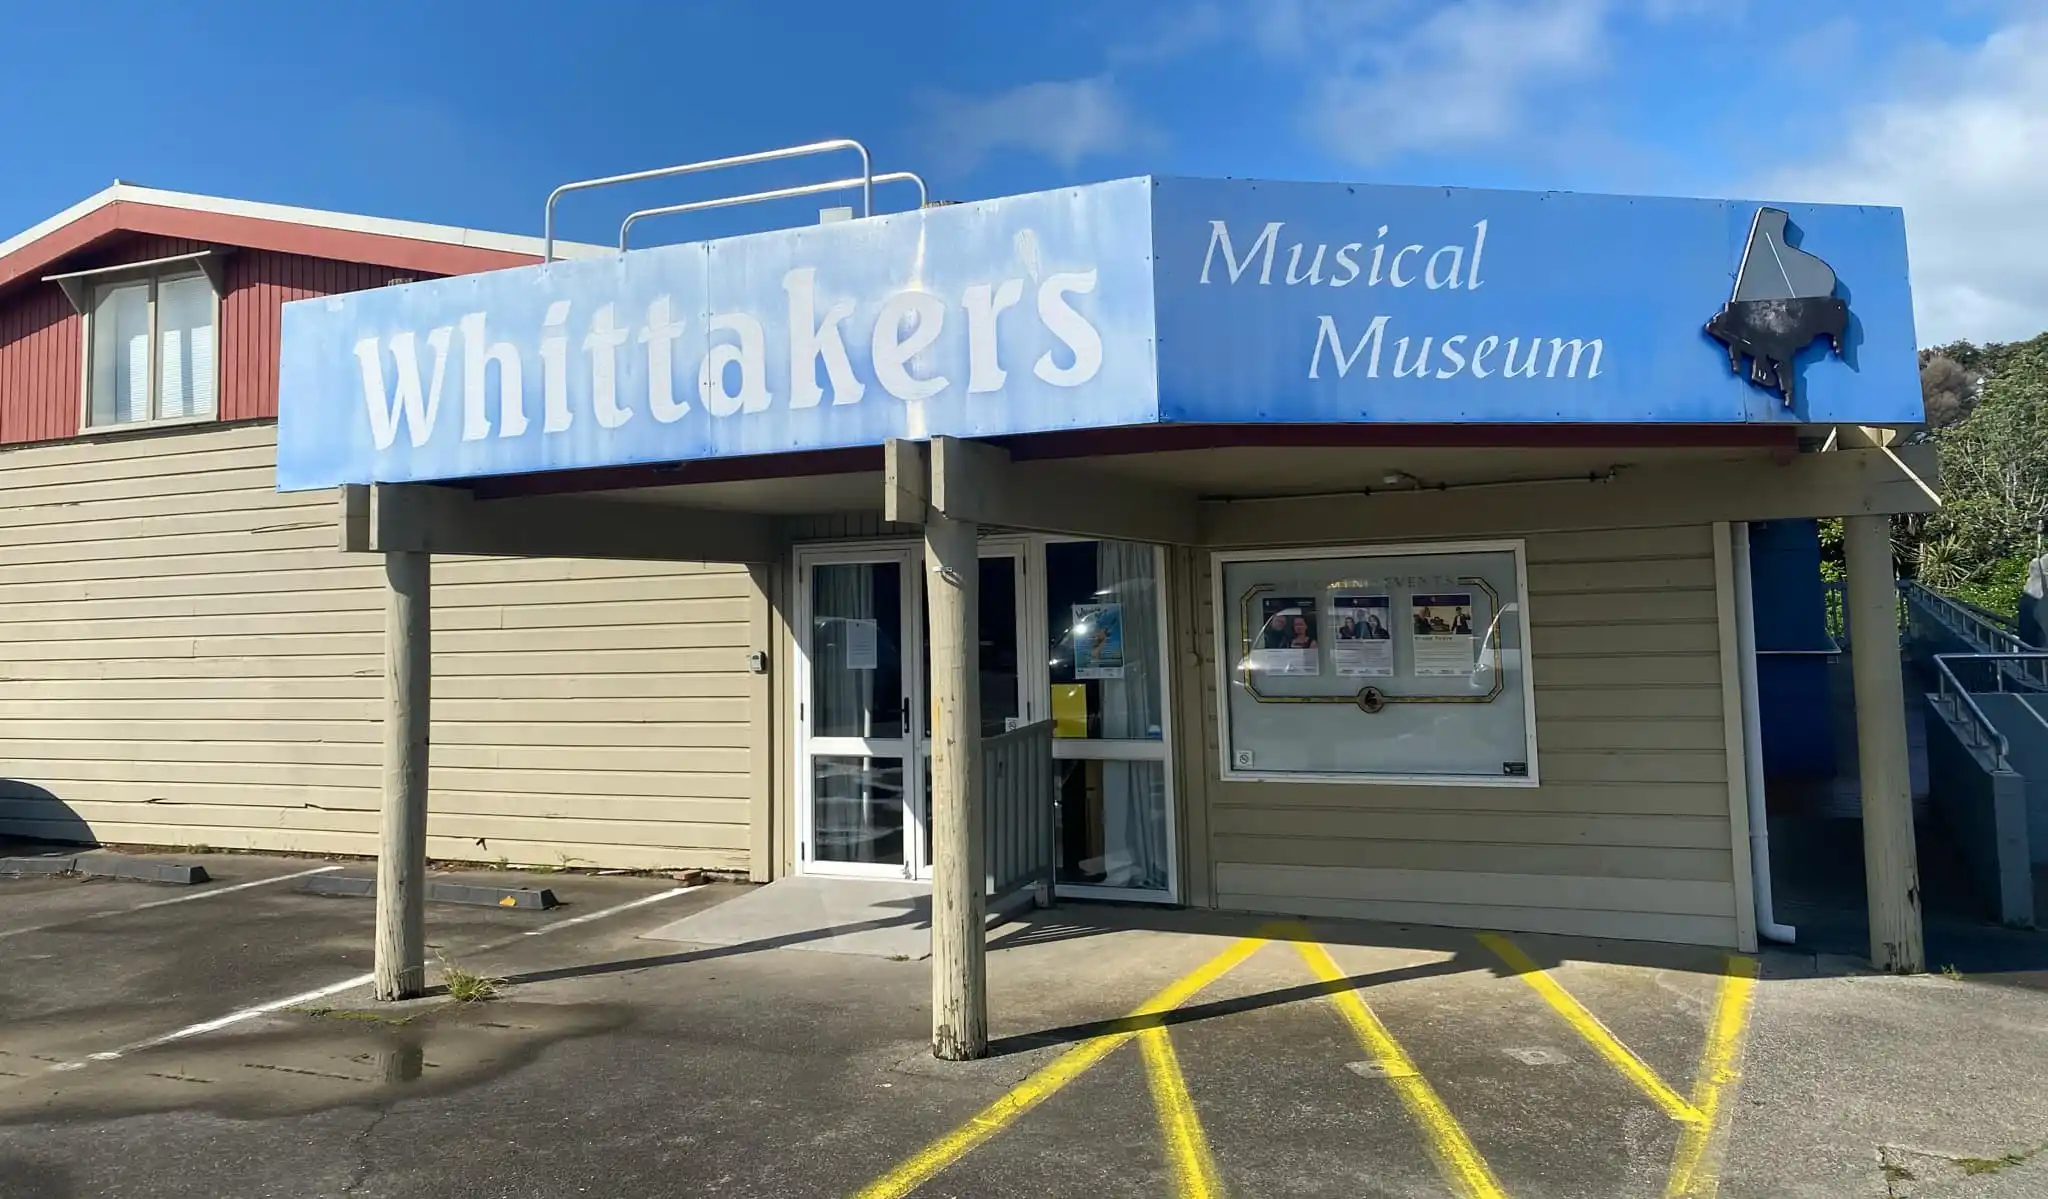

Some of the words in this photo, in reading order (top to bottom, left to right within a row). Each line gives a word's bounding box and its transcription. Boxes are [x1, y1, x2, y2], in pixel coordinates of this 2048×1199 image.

[1199, 219, 1488, 290] Musical
[354, 229, 1104, 450] Whittaker's
[1308, 315, 1603, 379] Museum
